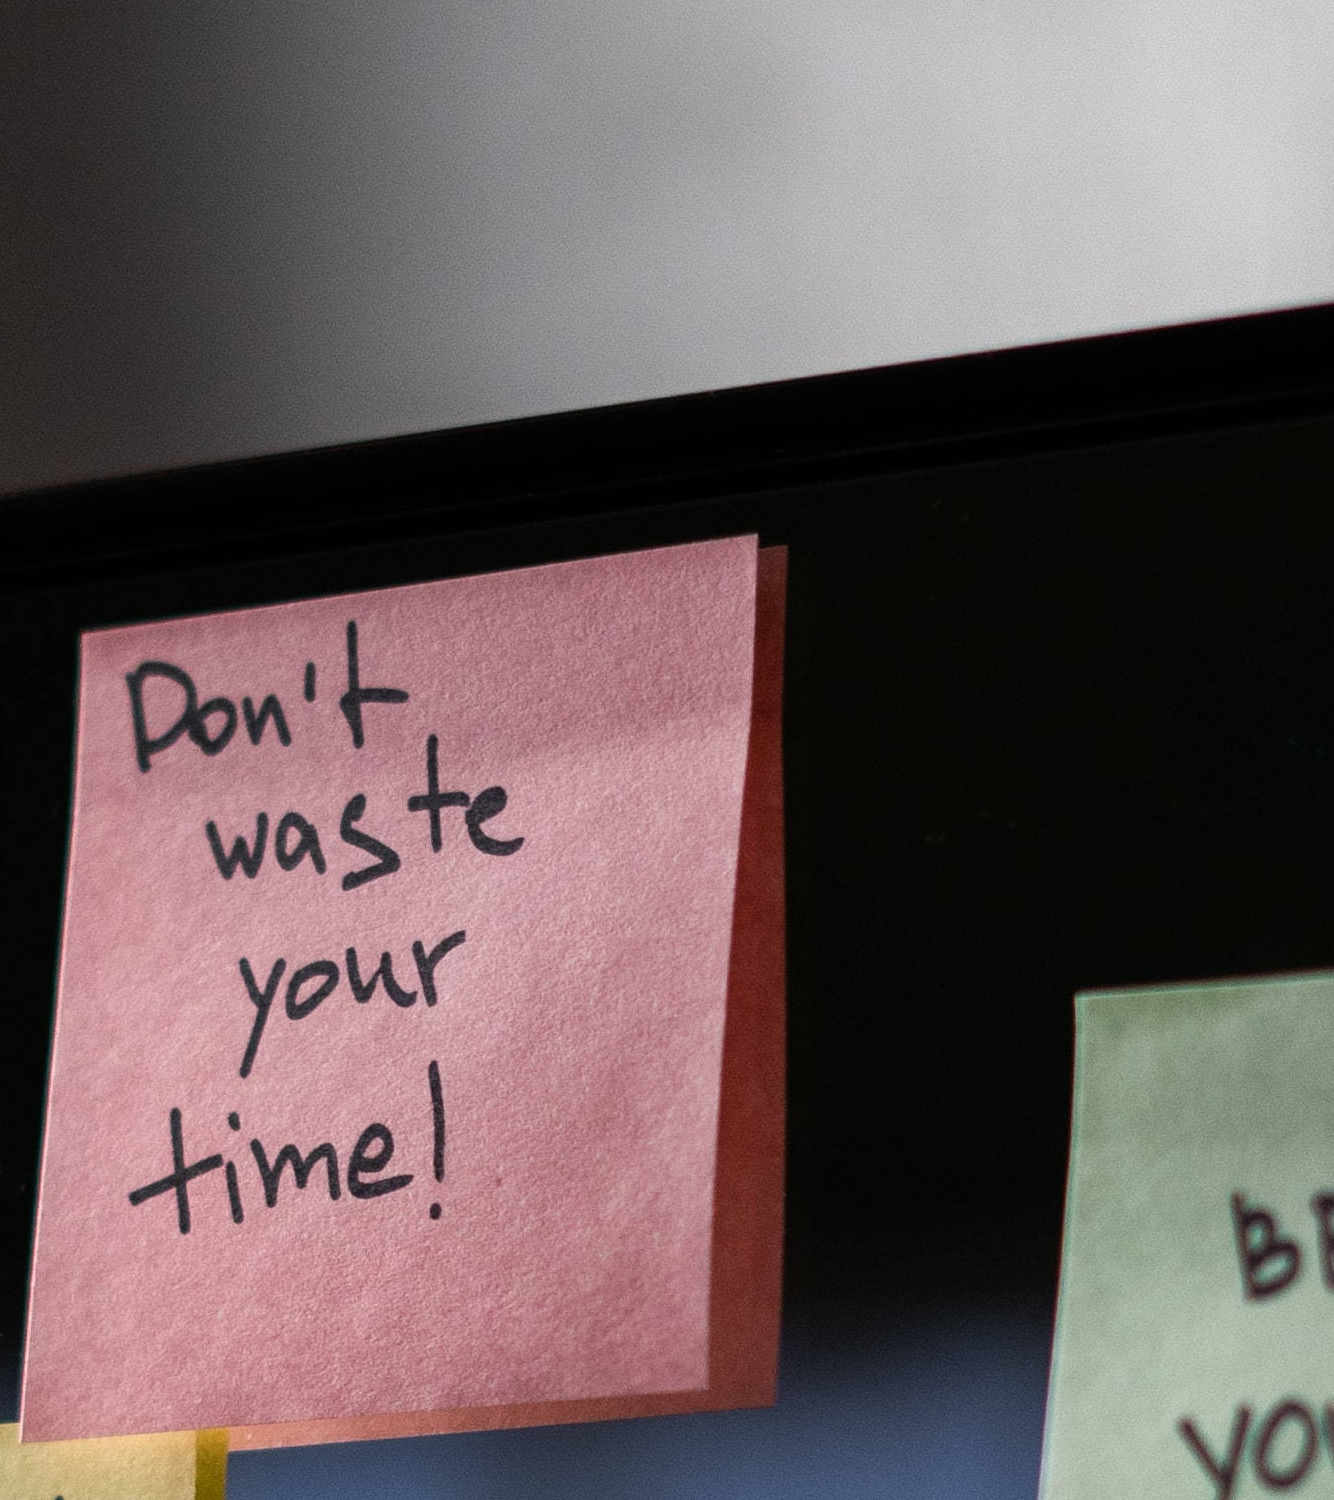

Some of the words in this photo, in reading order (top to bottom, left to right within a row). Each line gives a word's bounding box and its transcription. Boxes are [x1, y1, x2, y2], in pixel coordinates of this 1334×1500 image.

[126, 620, 409, 773] Don't
[206, 734, 525, 891] waste
[238, 930, 467, 1079] your
[128, 1059, 445, 1235] time!
